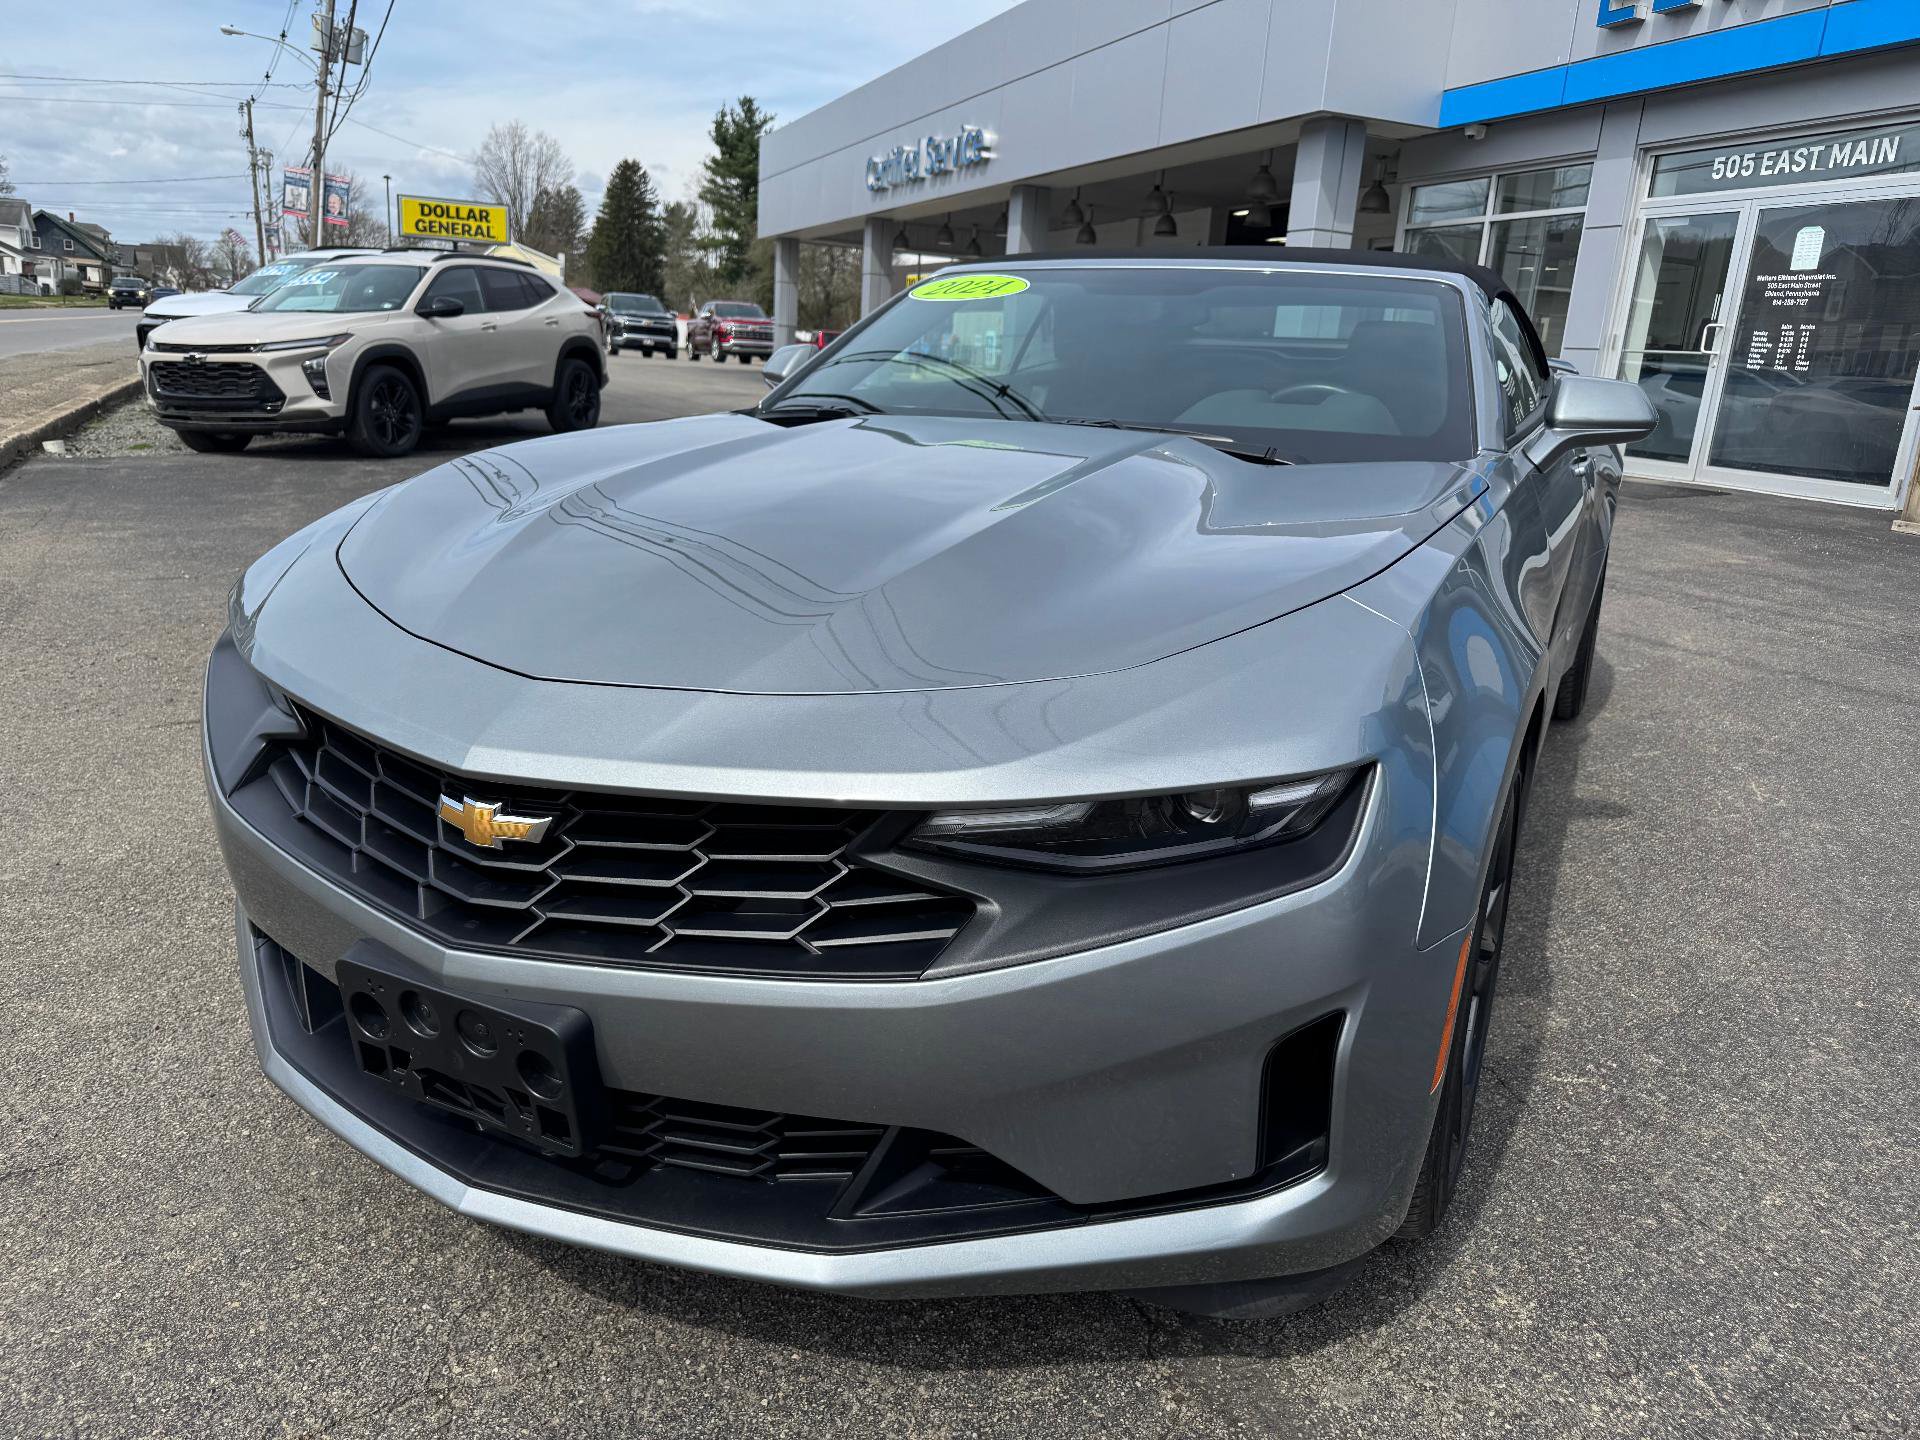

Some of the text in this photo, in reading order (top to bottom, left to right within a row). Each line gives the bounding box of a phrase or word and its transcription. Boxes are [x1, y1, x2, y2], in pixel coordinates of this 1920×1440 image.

[924, 124, 990, 177] Service
[1711, 136, 1900, 180] 505 EAST MAIN
[418, 203, 491, 223] DOLLAR
[414, 218, 496, 239] GENERAL
[922, 280, 1016, 296] 2024
